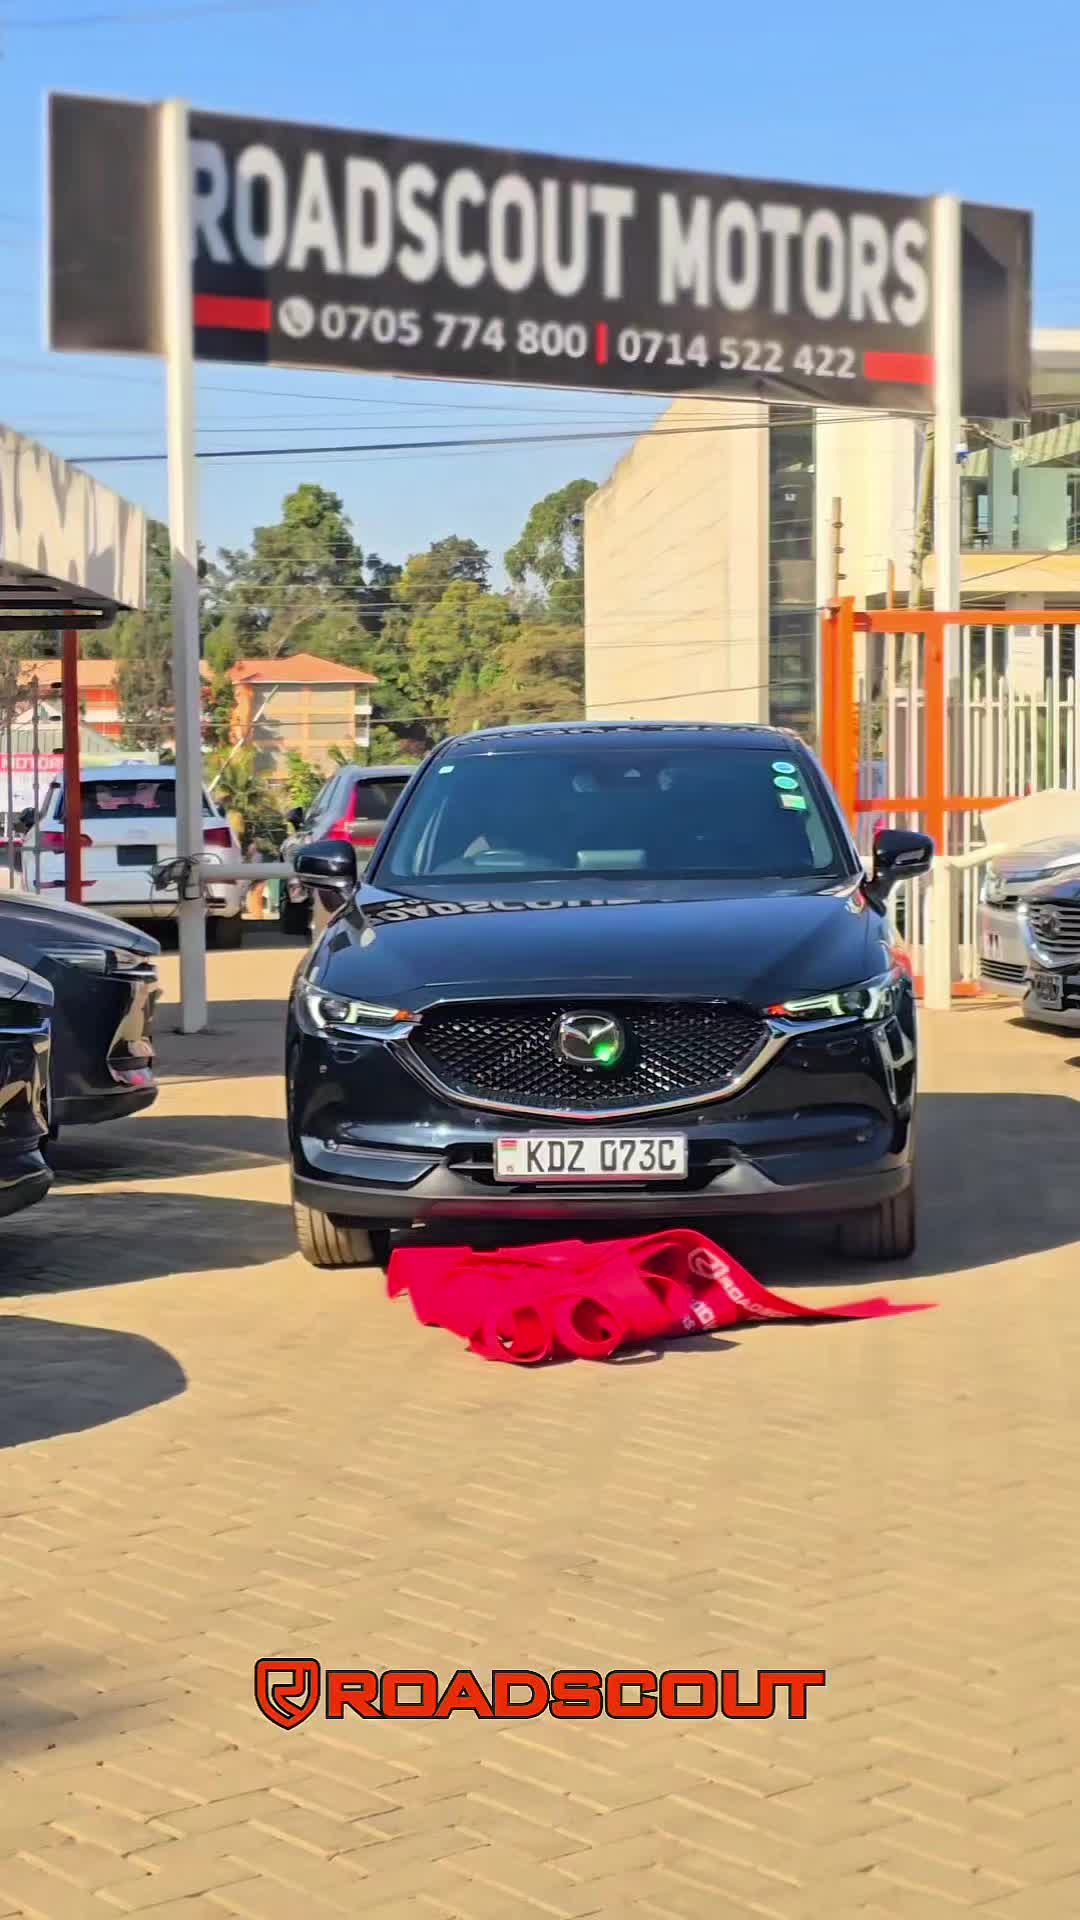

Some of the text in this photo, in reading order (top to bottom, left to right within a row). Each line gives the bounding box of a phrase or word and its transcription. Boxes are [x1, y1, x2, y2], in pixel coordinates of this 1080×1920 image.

[190, 139, 929, 327] ROADSCOUT MOTORS
[320, 304, 856, 379] 0705 774 800 0714 522 422
[527, 1139, 586, 1173] KDZ
